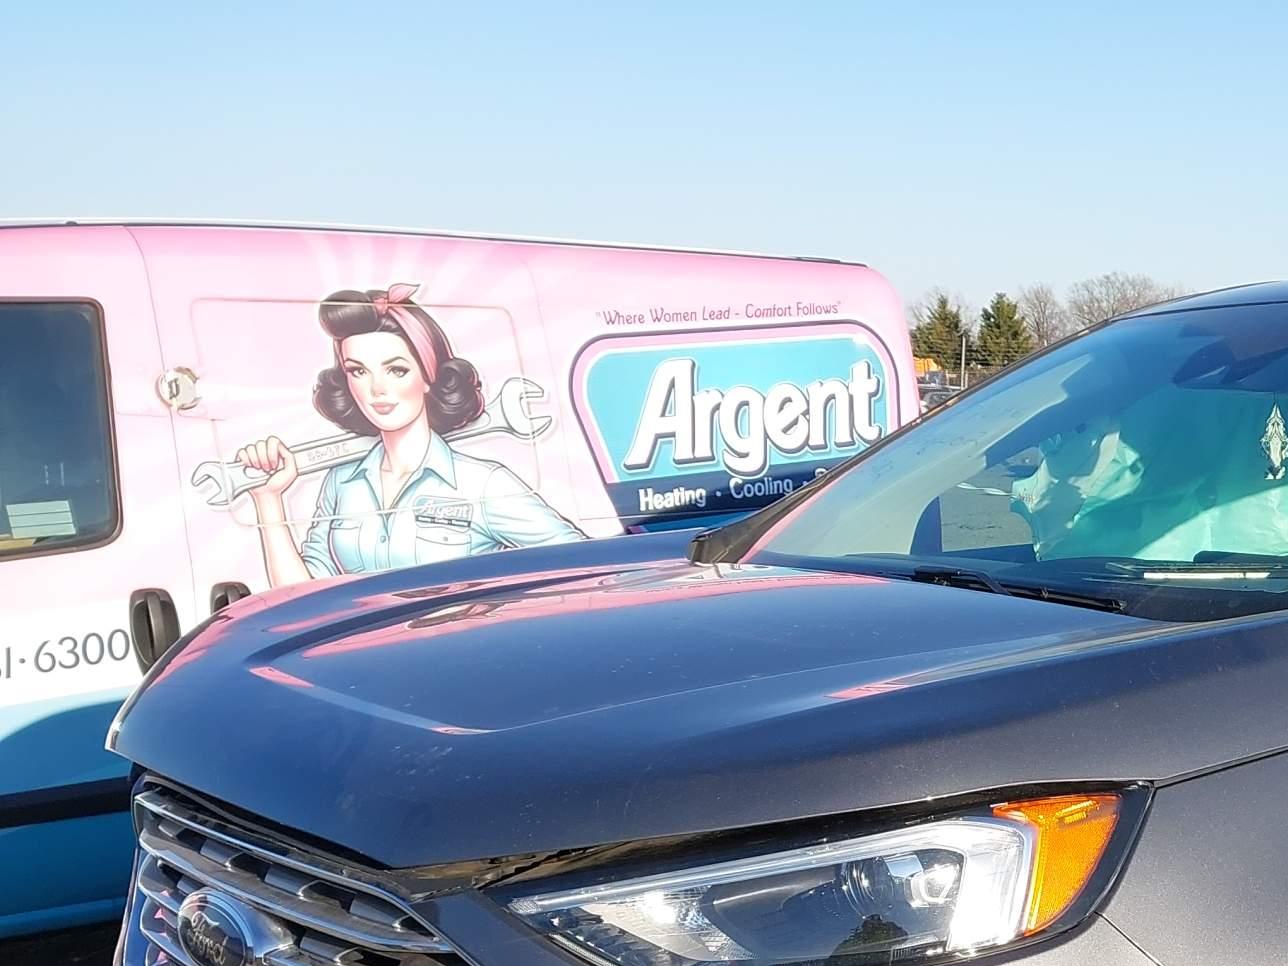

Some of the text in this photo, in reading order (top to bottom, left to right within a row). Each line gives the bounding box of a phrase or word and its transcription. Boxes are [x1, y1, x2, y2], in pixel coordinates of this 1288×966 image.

[649, 307, 697, 323] Women
[702, 305, 731, 321] Lead
[745, 303, 792, 319] Comfort
[624, 358, 882, 476] Argent
[638, 487, 706, 511] Heating
[729, 477, 793, 499] Cooling
[0, 628, 131, 679] 1·6300
